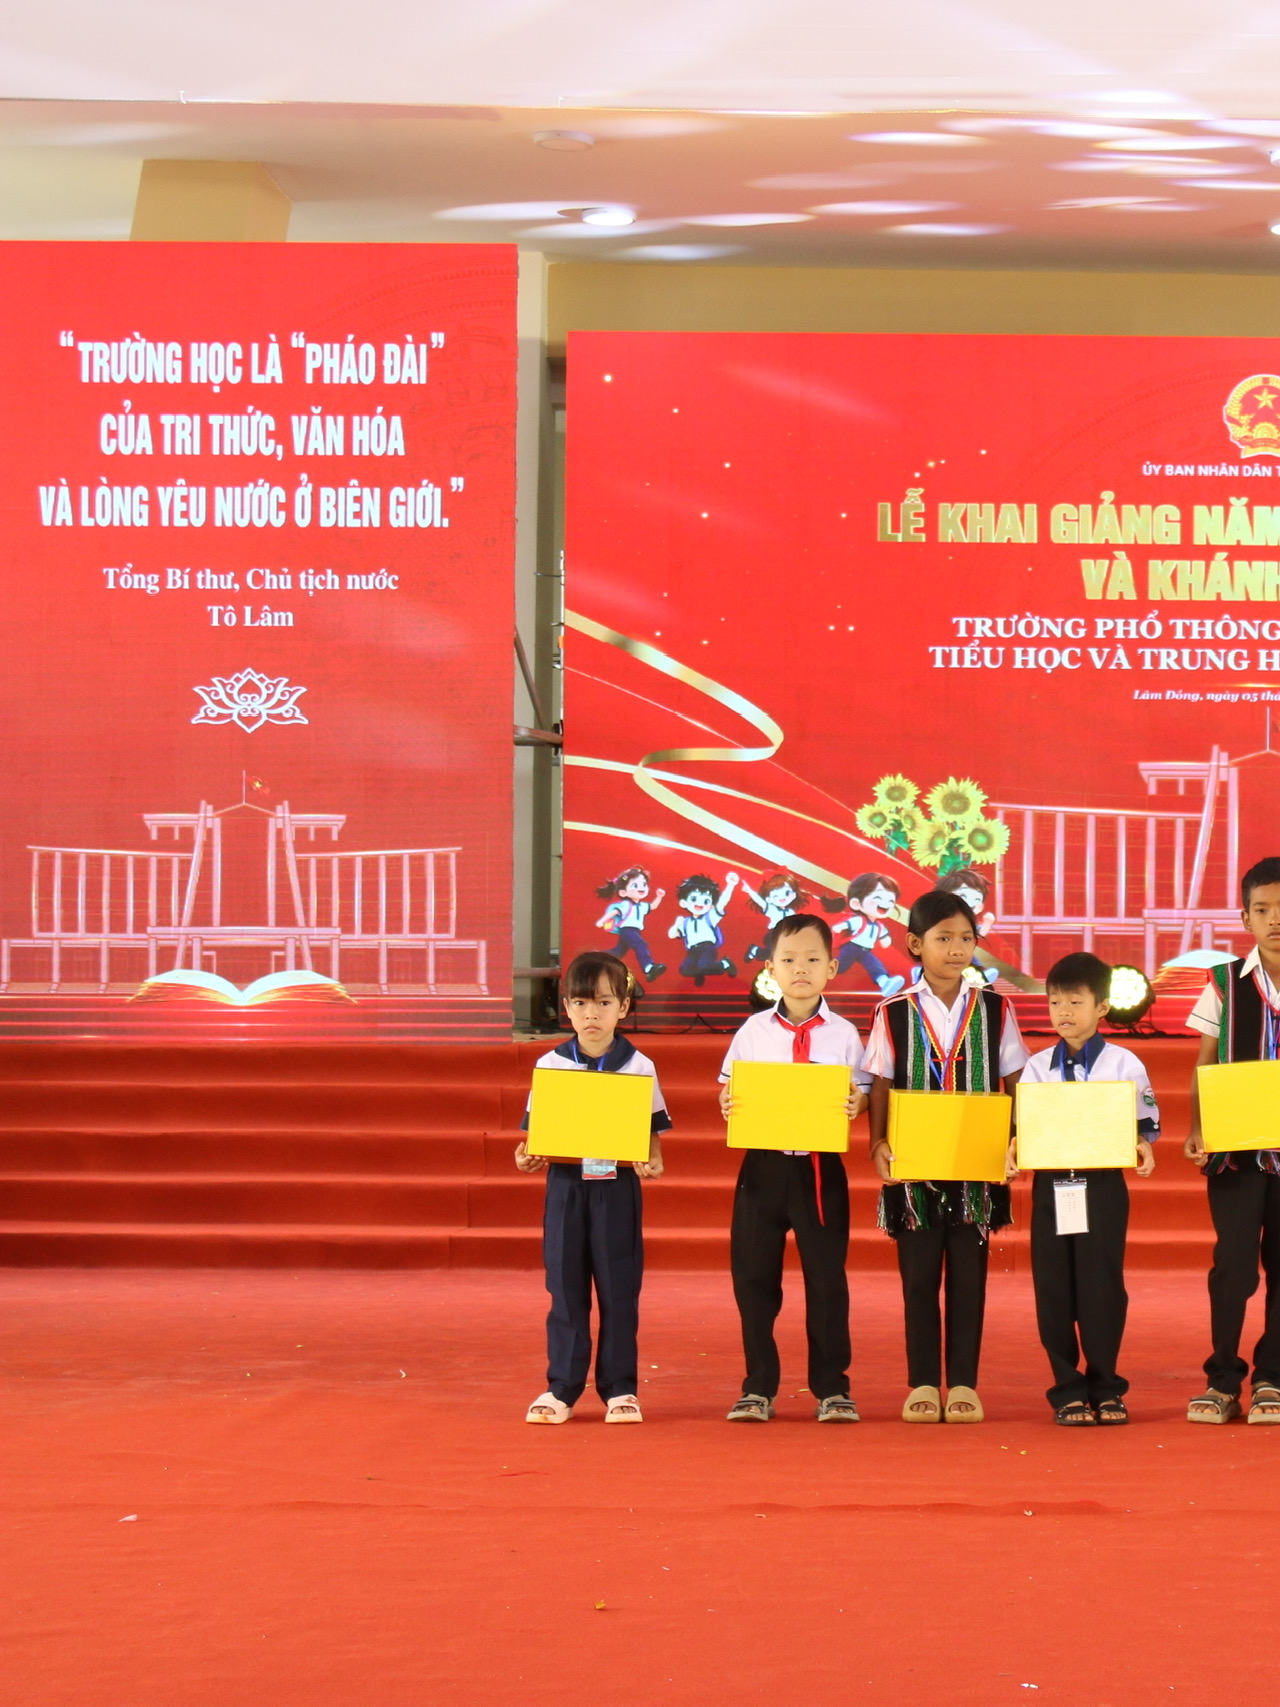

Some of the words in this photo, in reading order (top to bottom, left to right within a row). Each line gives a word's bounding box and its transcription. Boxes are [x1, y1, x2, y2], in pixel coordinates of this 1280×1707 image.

[190, 342, 242, 393] HỌC
[251, 334, 283, 384] LÀ
[101, 400, 153, 455] CỦA
[160, 414, 200, 455] TRI
[209, 406, 283, 460] THỨC,
[291, 406, 344, 455] VĂN
[353, 406, 405, 456] HÓA
[1165, 464, 1194, 477] BAN
[1198, 463, 1239, 477] NHÂN
[1242, 463, 1272, 477] DÂN
[39, 478, 73, 526] VÀ
[81, 477, 149, 527] LÒNG
[157, 479, 206, 527] YÊU
[215, 479, 286, 527] NƯỚC
[295, 473, 312, 527] Ở
[320, 479, 380, 527] BIÊN
[878, 487, 926, 542] LỄ
[938, 503, 1038, 543] KHAI
[1050, 491, 1181, 545] GIẢNG
[103, 563, 159, 594] Tổng
[166, 568, 190, 590] Bí
[196, 568, 240, 591] thư,
[246, 567, 292, 590] Chủ
[299, 568, 339, 597] tịch
[347, 568, 399, 590] nước
[1080, 551, 1137, 600] VÀ
[207, 605, 237, 627] Tô
[244, 605, 294, 627] Lâm
[953, 612, 1087, 639] TRƯỜNG
[1095, 610, 1162, 639] PHỔ
[929, 640, 1005, 668] TIỂU
[1013, 647, 1081, 673] HỌC
[1087, 644, 1132, 670] VÀ
[1138, 648, 1250, 671] TRUNG
[1242, 693, 1258, 702] 05
